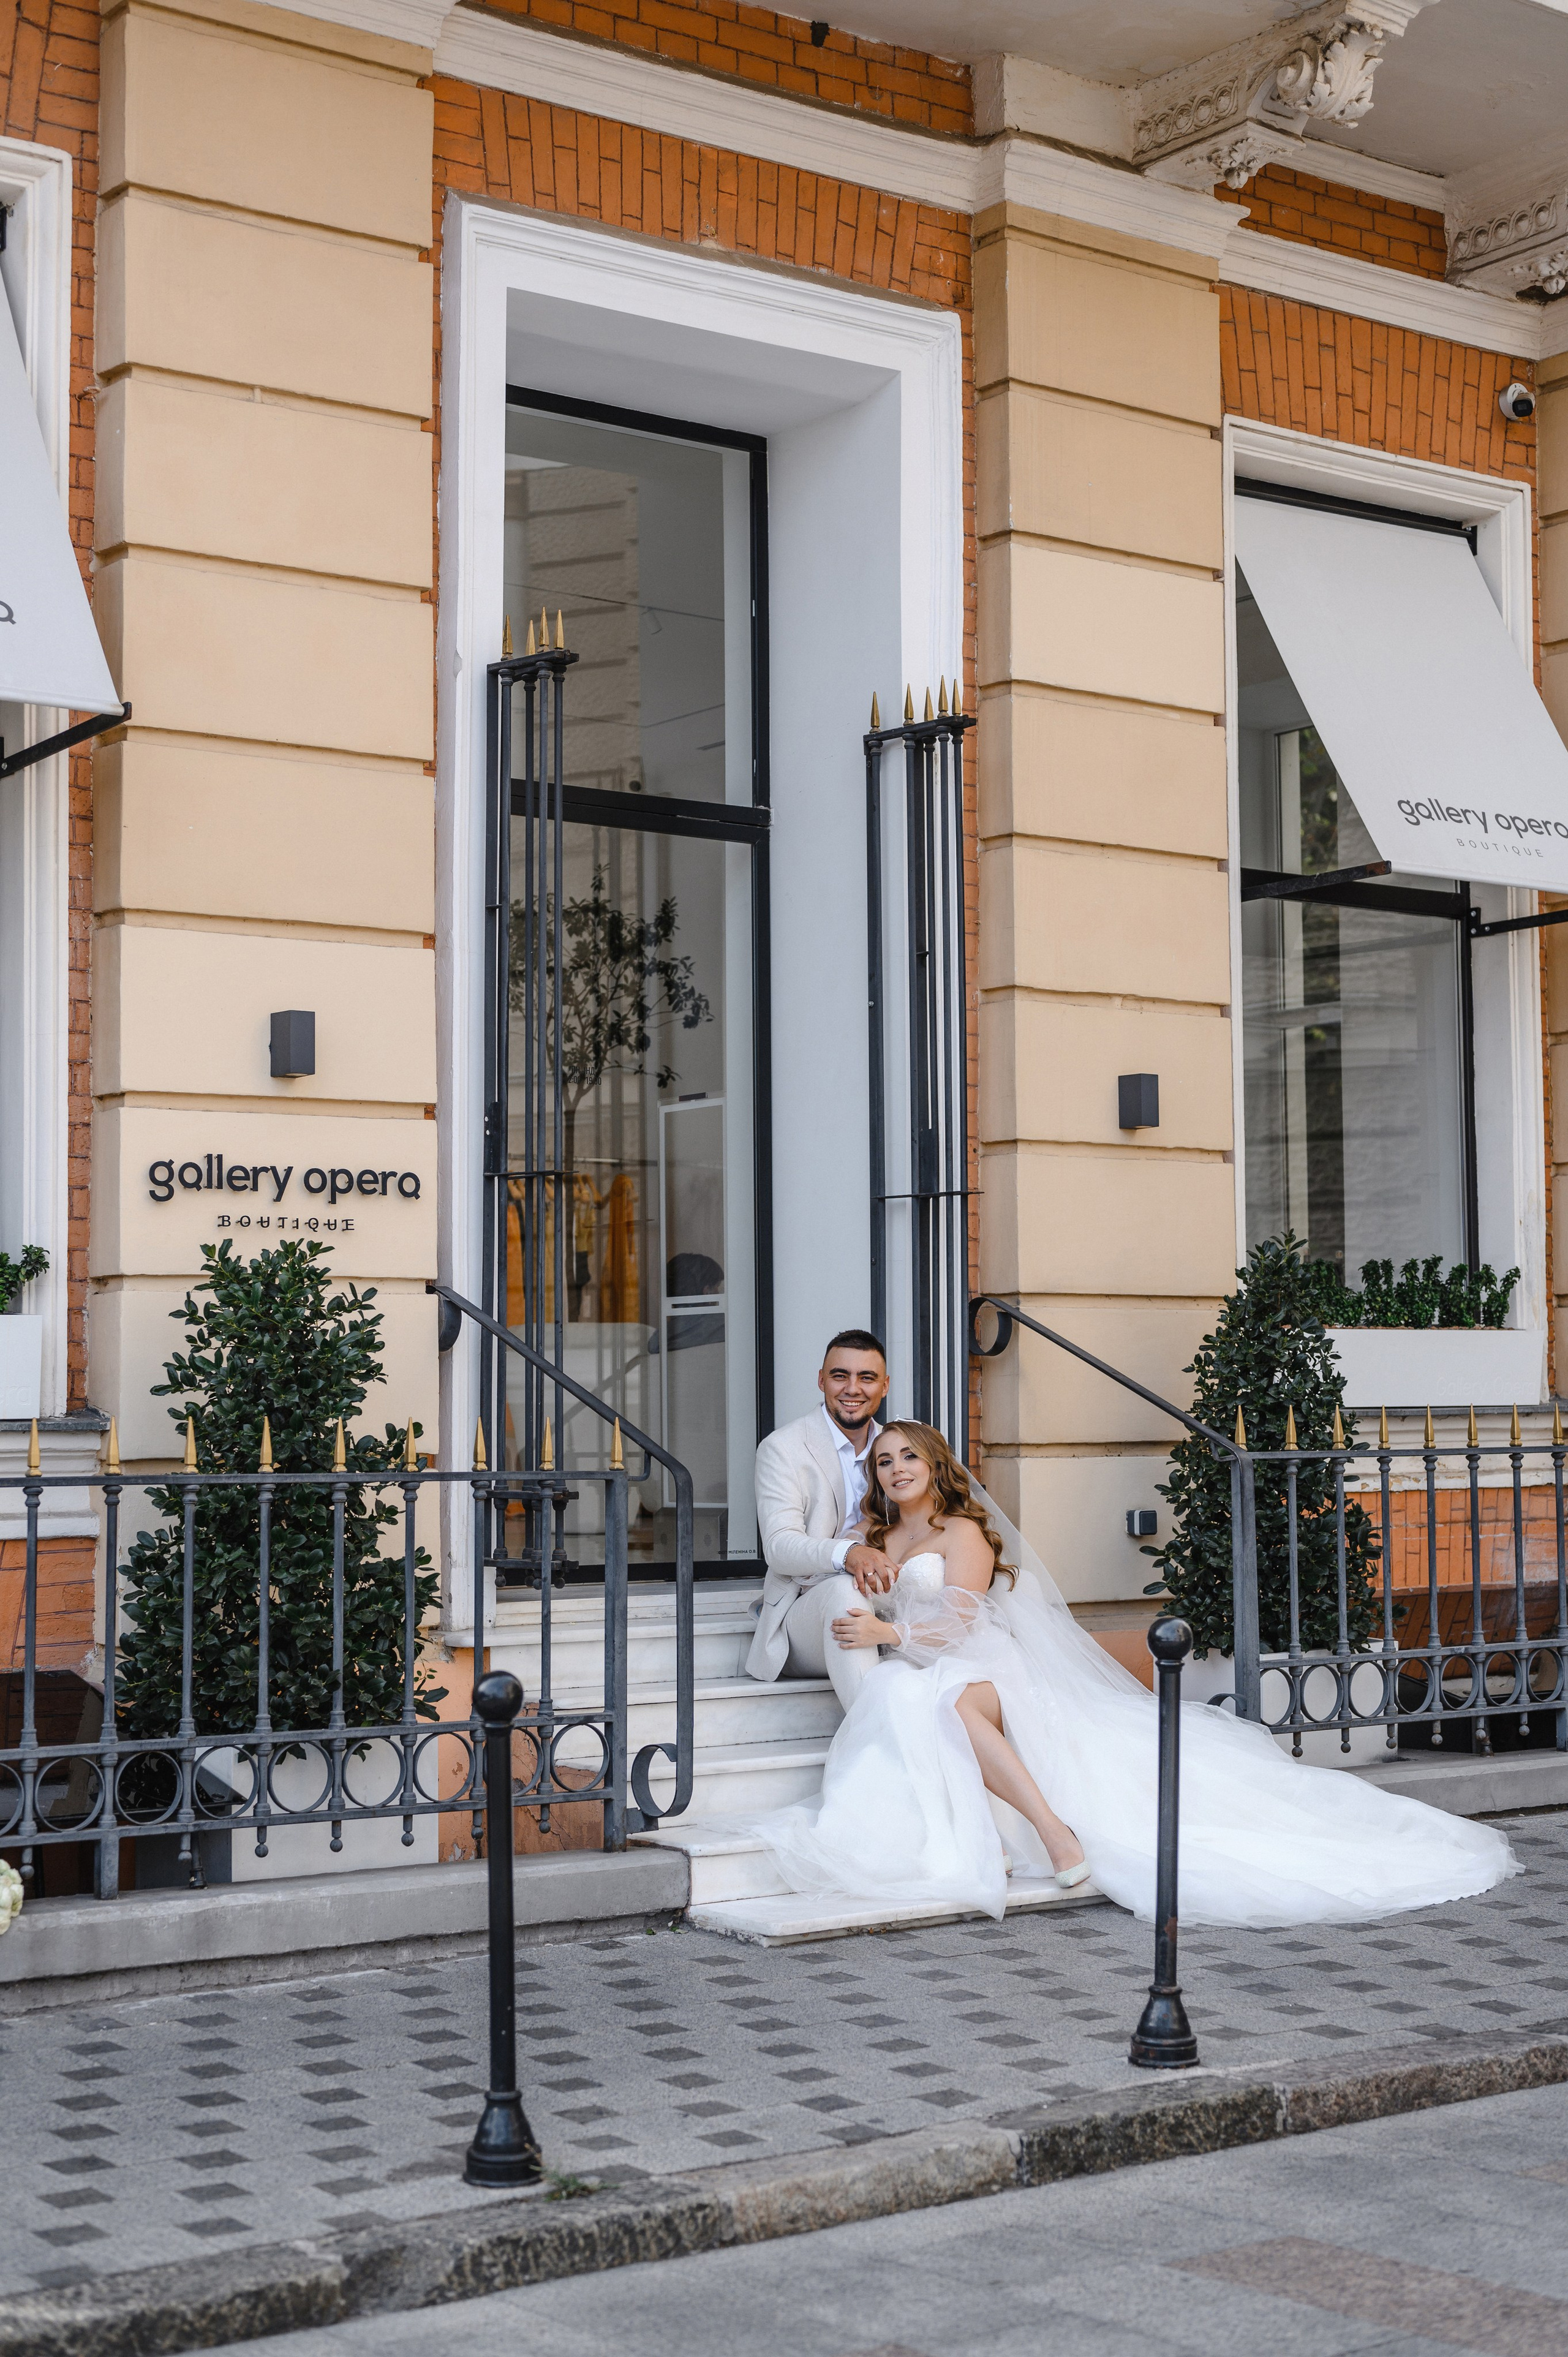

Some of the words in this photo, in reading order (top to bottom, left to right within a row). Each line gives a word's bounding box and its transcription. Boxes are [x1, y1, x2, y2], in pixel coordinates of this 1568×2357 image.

[1397, 797, 1488, 834] gallery
[1456, 838, 1544, 858] BOUTIQUE
[148, 1153, 293, 1202] gallery
[303, 1167, 421, 1205] opera
[218, 1215, 355, 1232] BOUTIQUE
